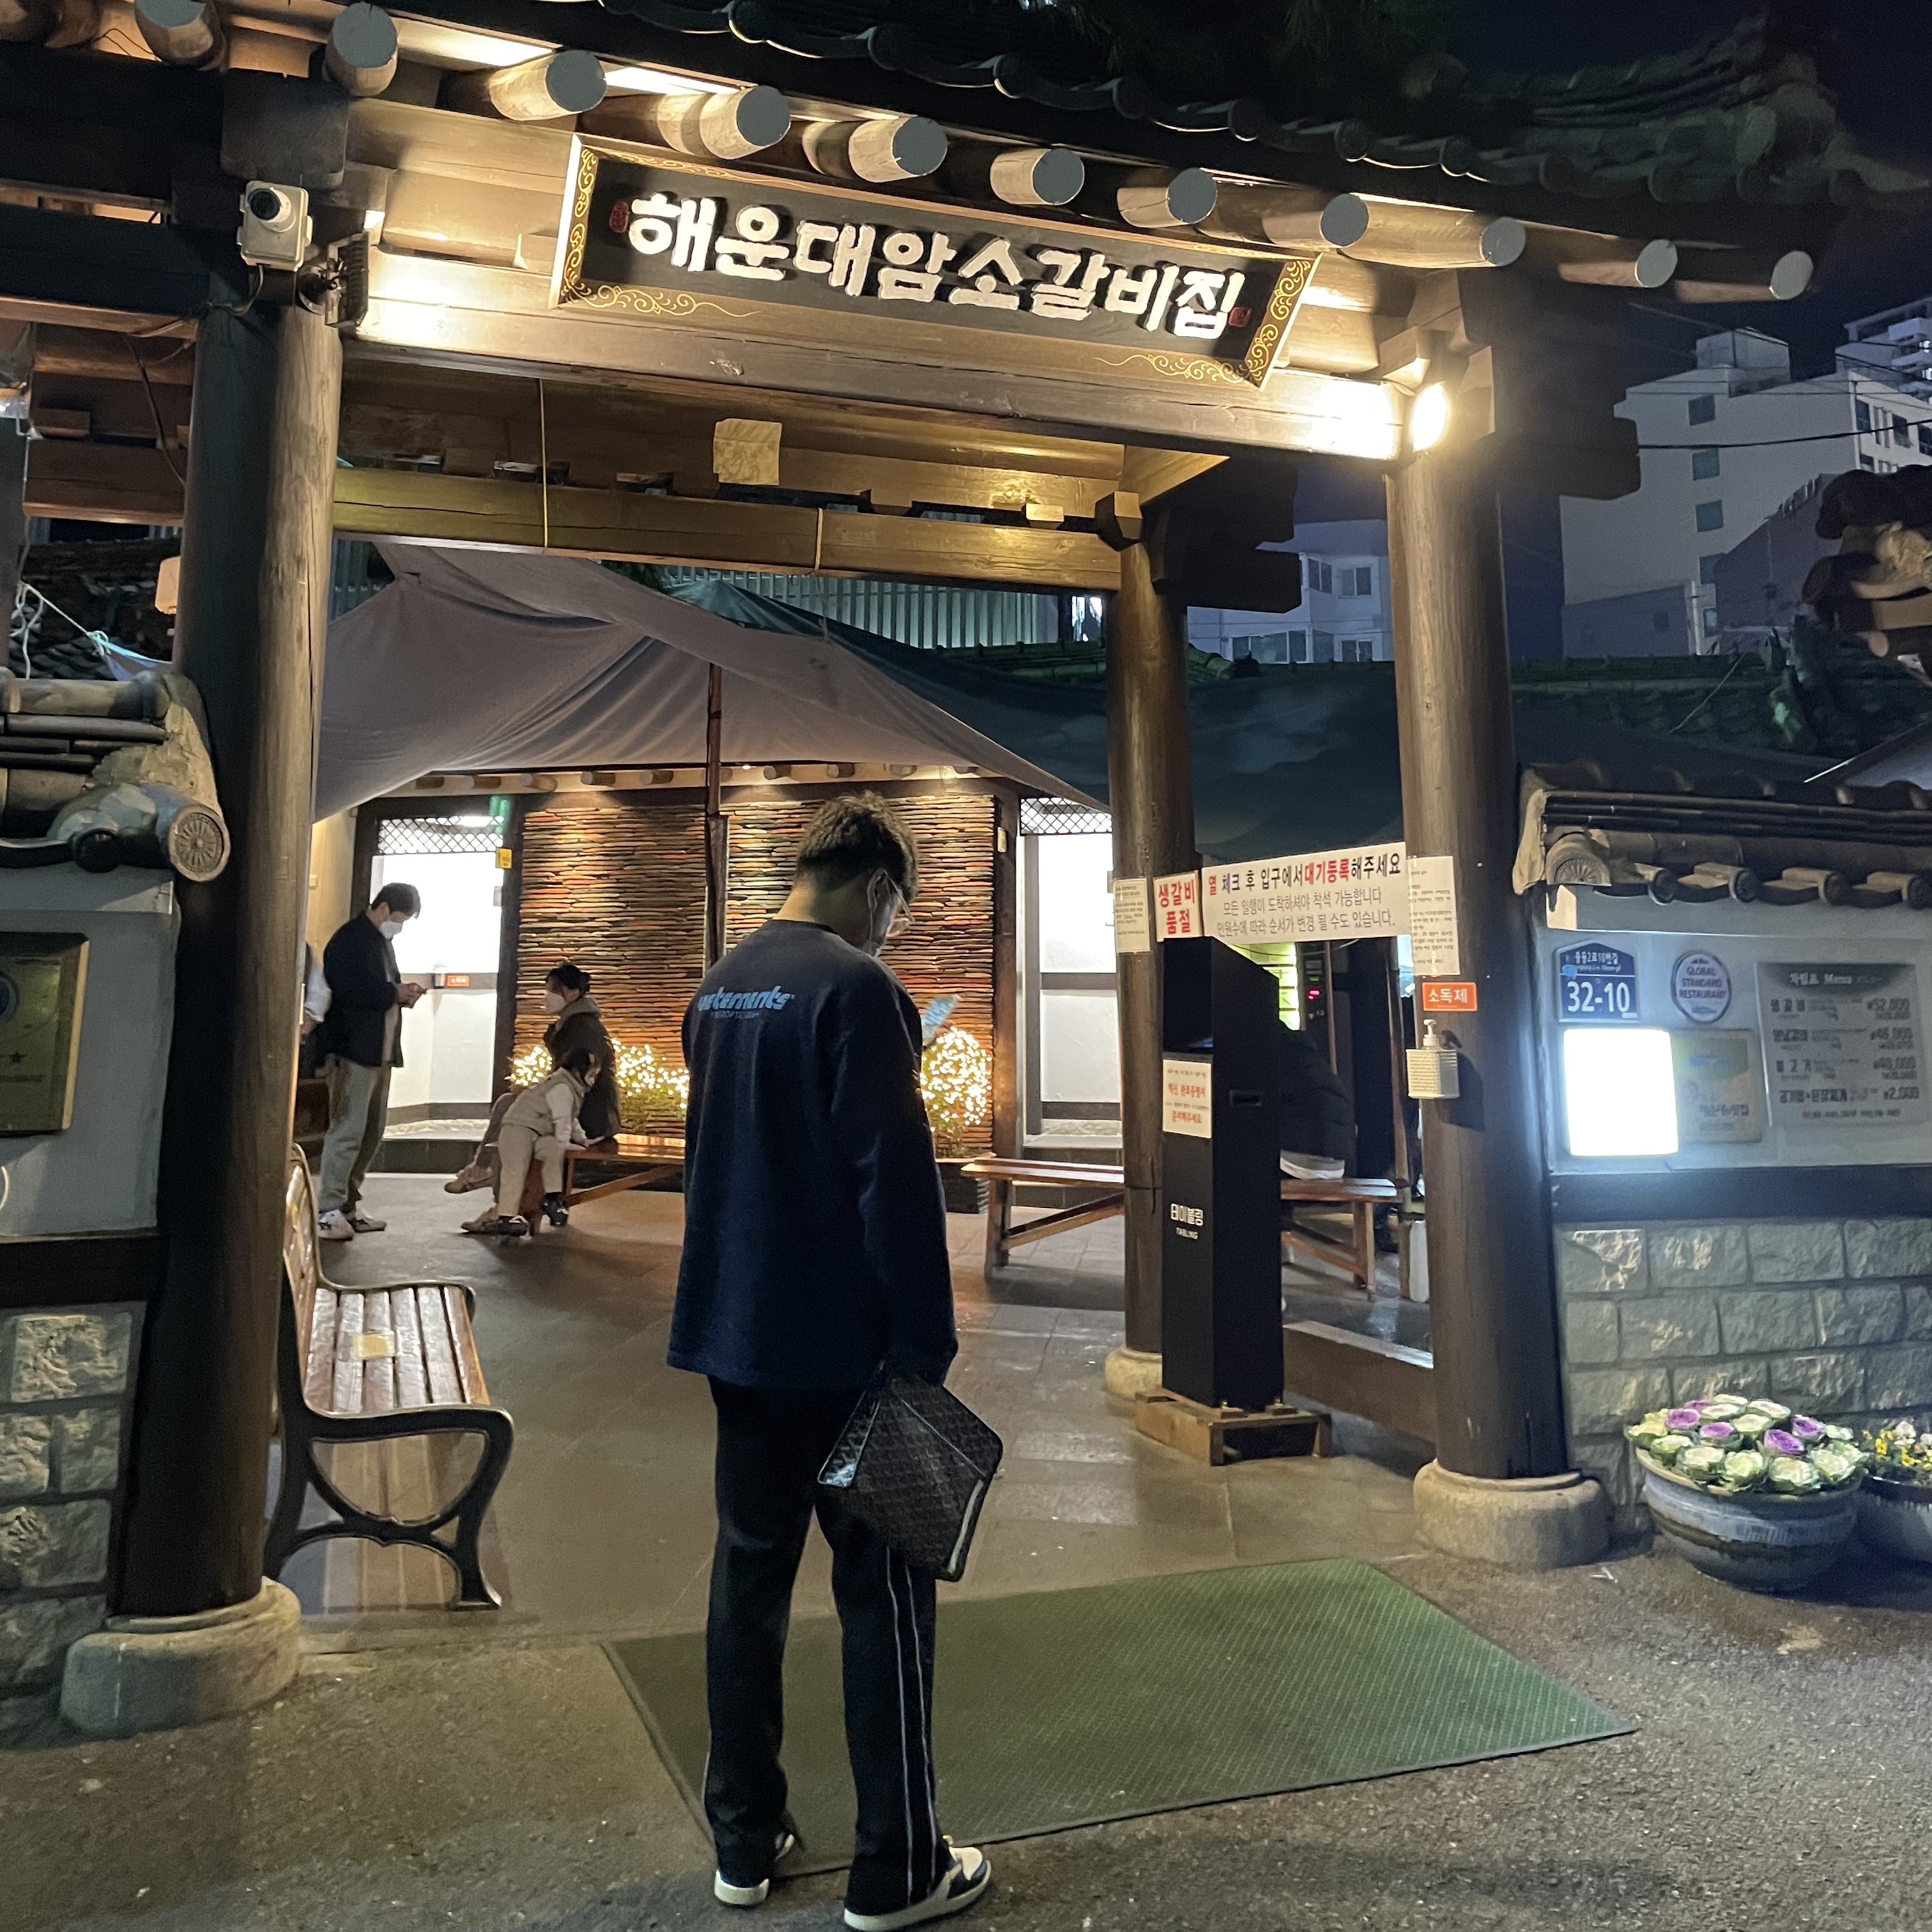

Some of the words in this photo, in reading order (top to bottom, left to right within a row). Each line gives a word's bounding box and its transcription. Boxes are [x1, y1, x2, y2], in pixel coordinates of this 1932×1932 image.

[627, 190, 1246, 340] 해운대암소갈비집
[1158, 879, 1195, 908] 생갈비
[1209, 875, 1216, 896] 열
[1222, 873, 1240, 894] 체크
[1246, 870, 1255, 892] 후
[1223, 901, 1239, 916] 모든
[1241, 898, 1265, 915] 일행이
[1268, 893, 1310, 912] 도착하셔야
[1314, 891, 1331, 909] 착석
[1335, 886, 1382, 907] 가능합니다
[1166, 908, 1191, 935] 품절
[1217, 919, 1247, 937] 인원수에
[1250, 919, 1266, 935] 따라
[1269, 916, 1294, 933] 순서가
[1297, 914, 1315, 932] 변경
[1330, 913, 1350, 930] 수도
[1352, 908, 1395, 928] 있습니다.
[1428, 988, 1468, 1004] 소독제
[1567, 981, 1630, 1013] 32-10
